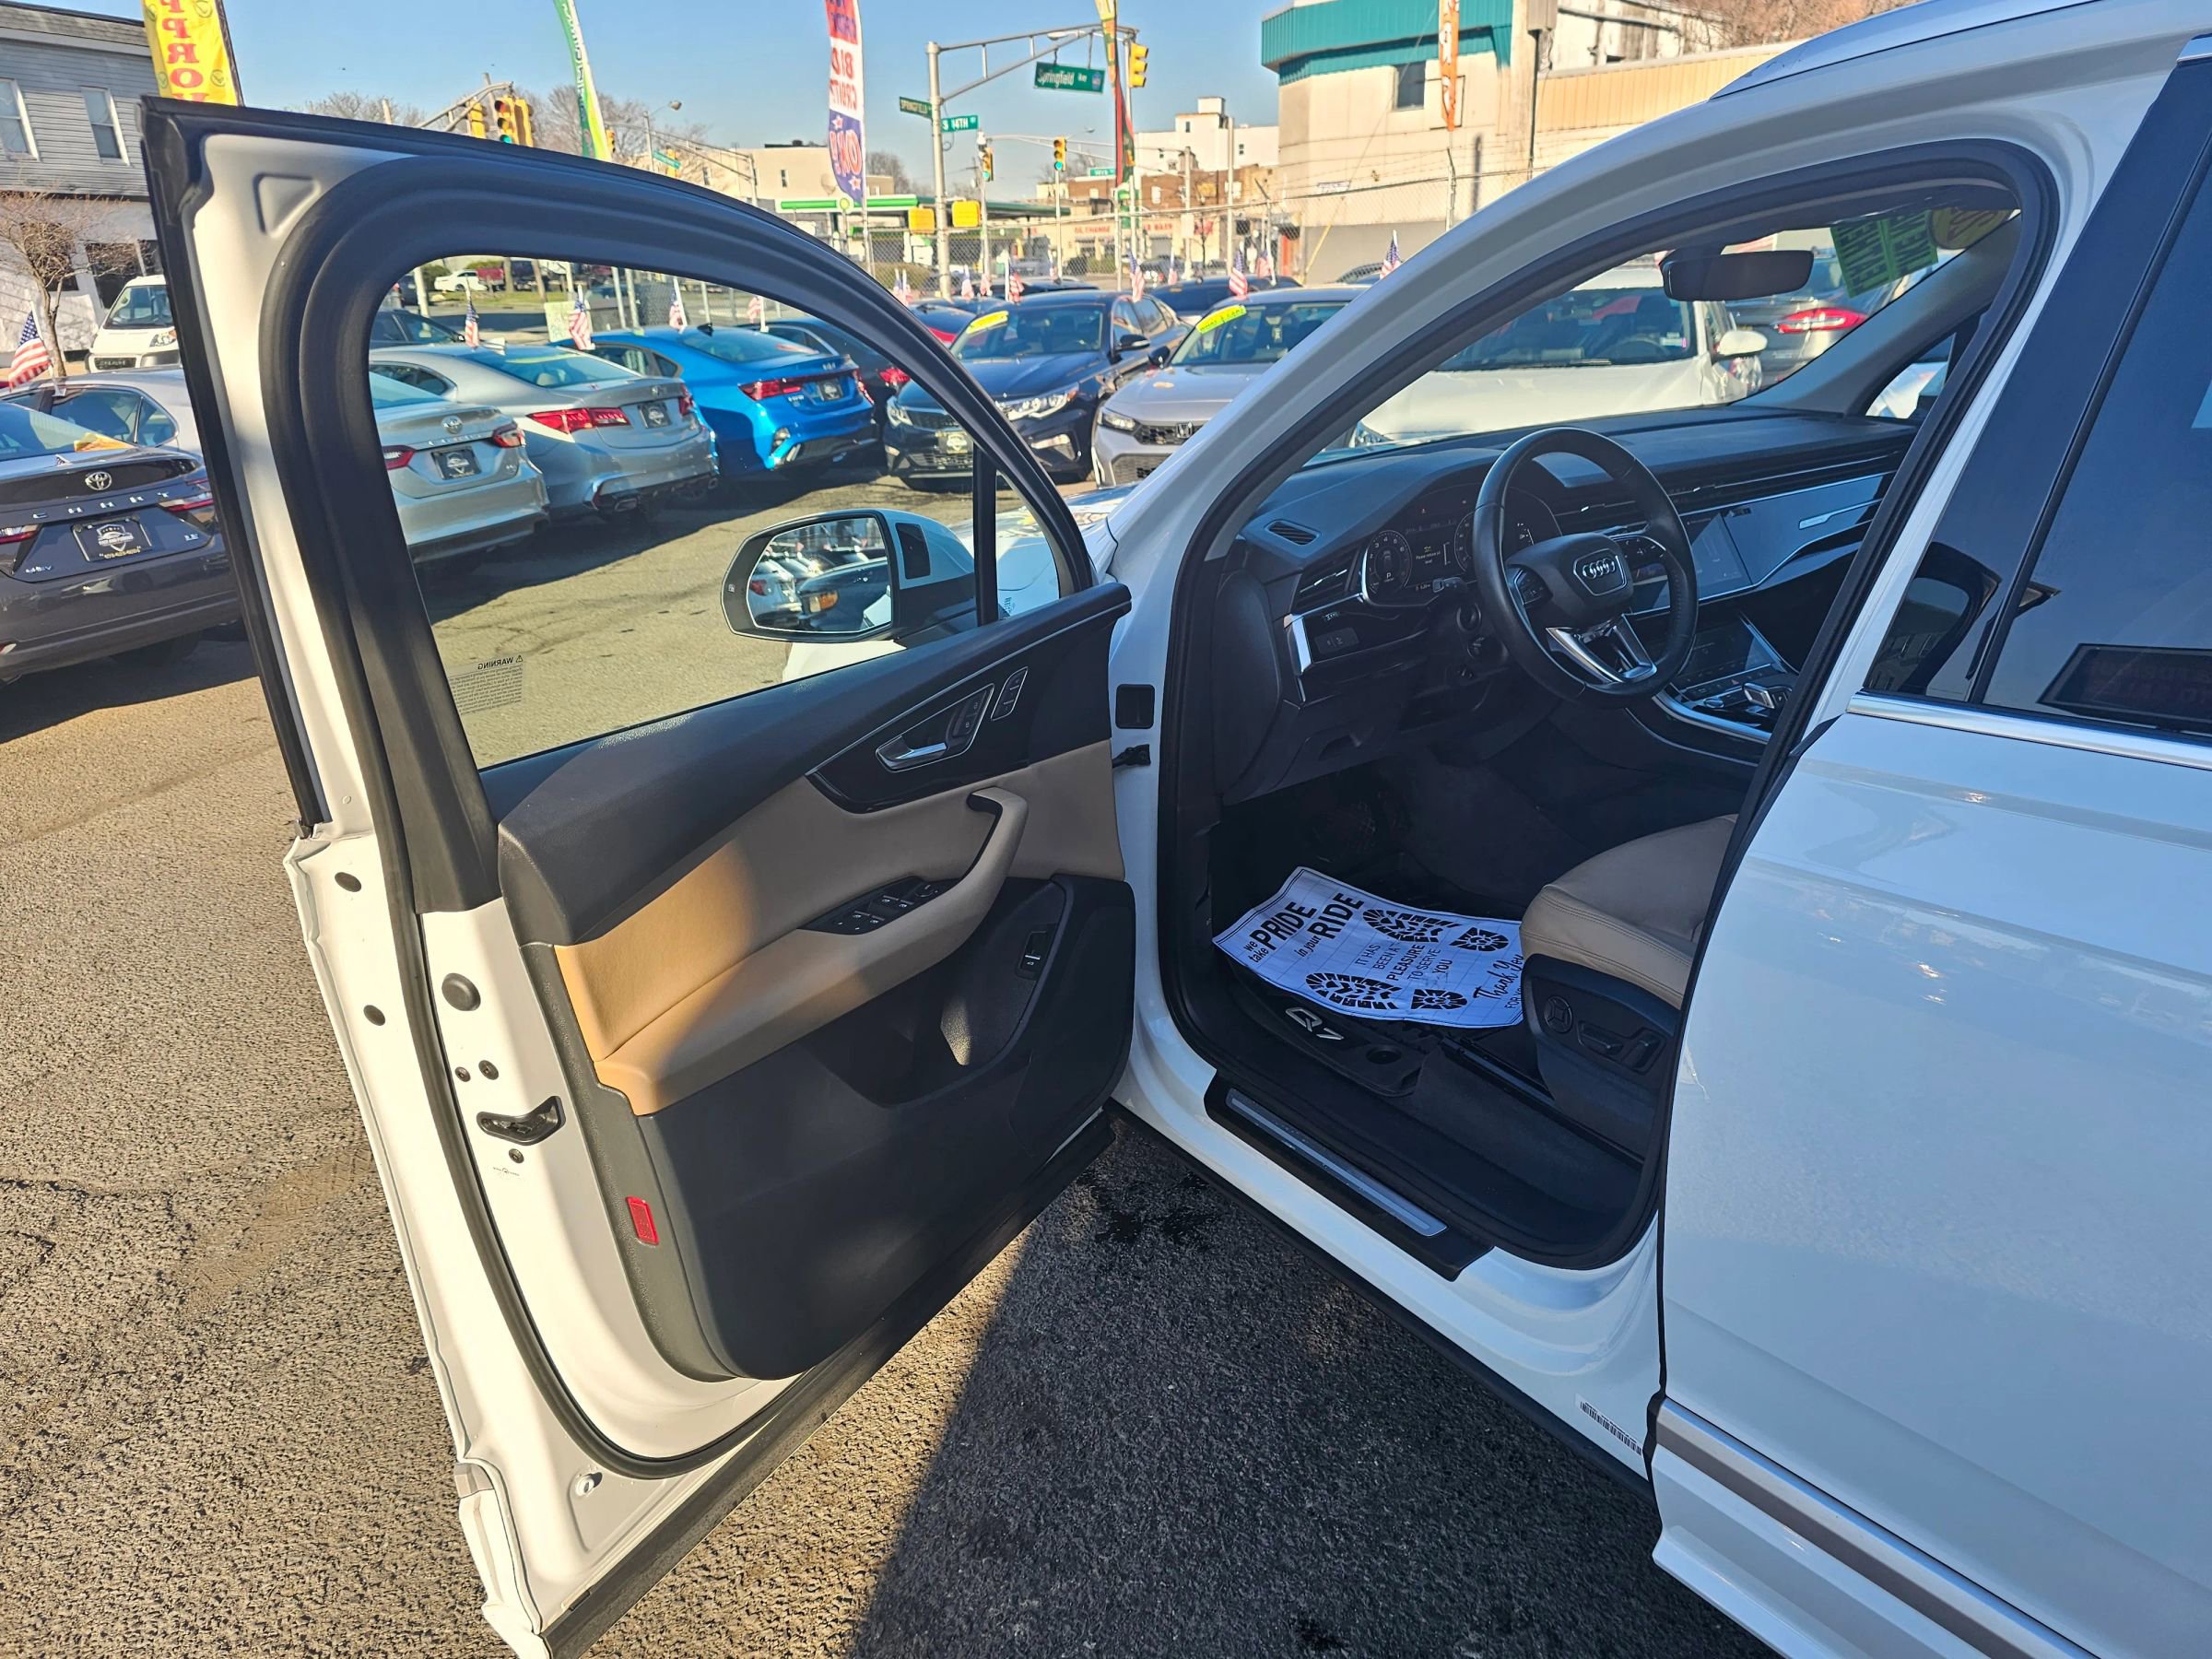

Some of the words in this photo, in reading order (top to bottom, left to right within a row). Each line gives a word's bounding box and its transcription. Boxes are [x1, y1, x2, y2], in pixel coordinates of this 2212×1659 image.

[1037, 69, 1075, 88] Springfield
[942, 120, 949, 131] S
[1307, 892, 1364, 939] RIDE
[1249, 901, 1318, 951] PRIDE
[1243, 941, 1258, 952] we
[1294, 948, 1306, 958] in
[1304, 935, 1322, 953] your
[1248, 947, 1269, 963] take
[1354, 957, 1371, 966] IT
[1365, 944, 1382, 959] HAS
[1373, 952, 1397, 970] BEEN
[1391, 947, 1401, 955] A
[1386, 944, 1426, 981] PLEASURE
[1407, 971, 1424, 981] TO
[1417, 948, 1441, 971] SERVE
[1493, 954, 1524, 971] You
[1432, 959, 1453, 974] YOU
[1473, 971, 1519, 1000] Thank
[1504, 996, 1523, 1009] FOR
[1285, 1006, 1345, 1041] Q7
